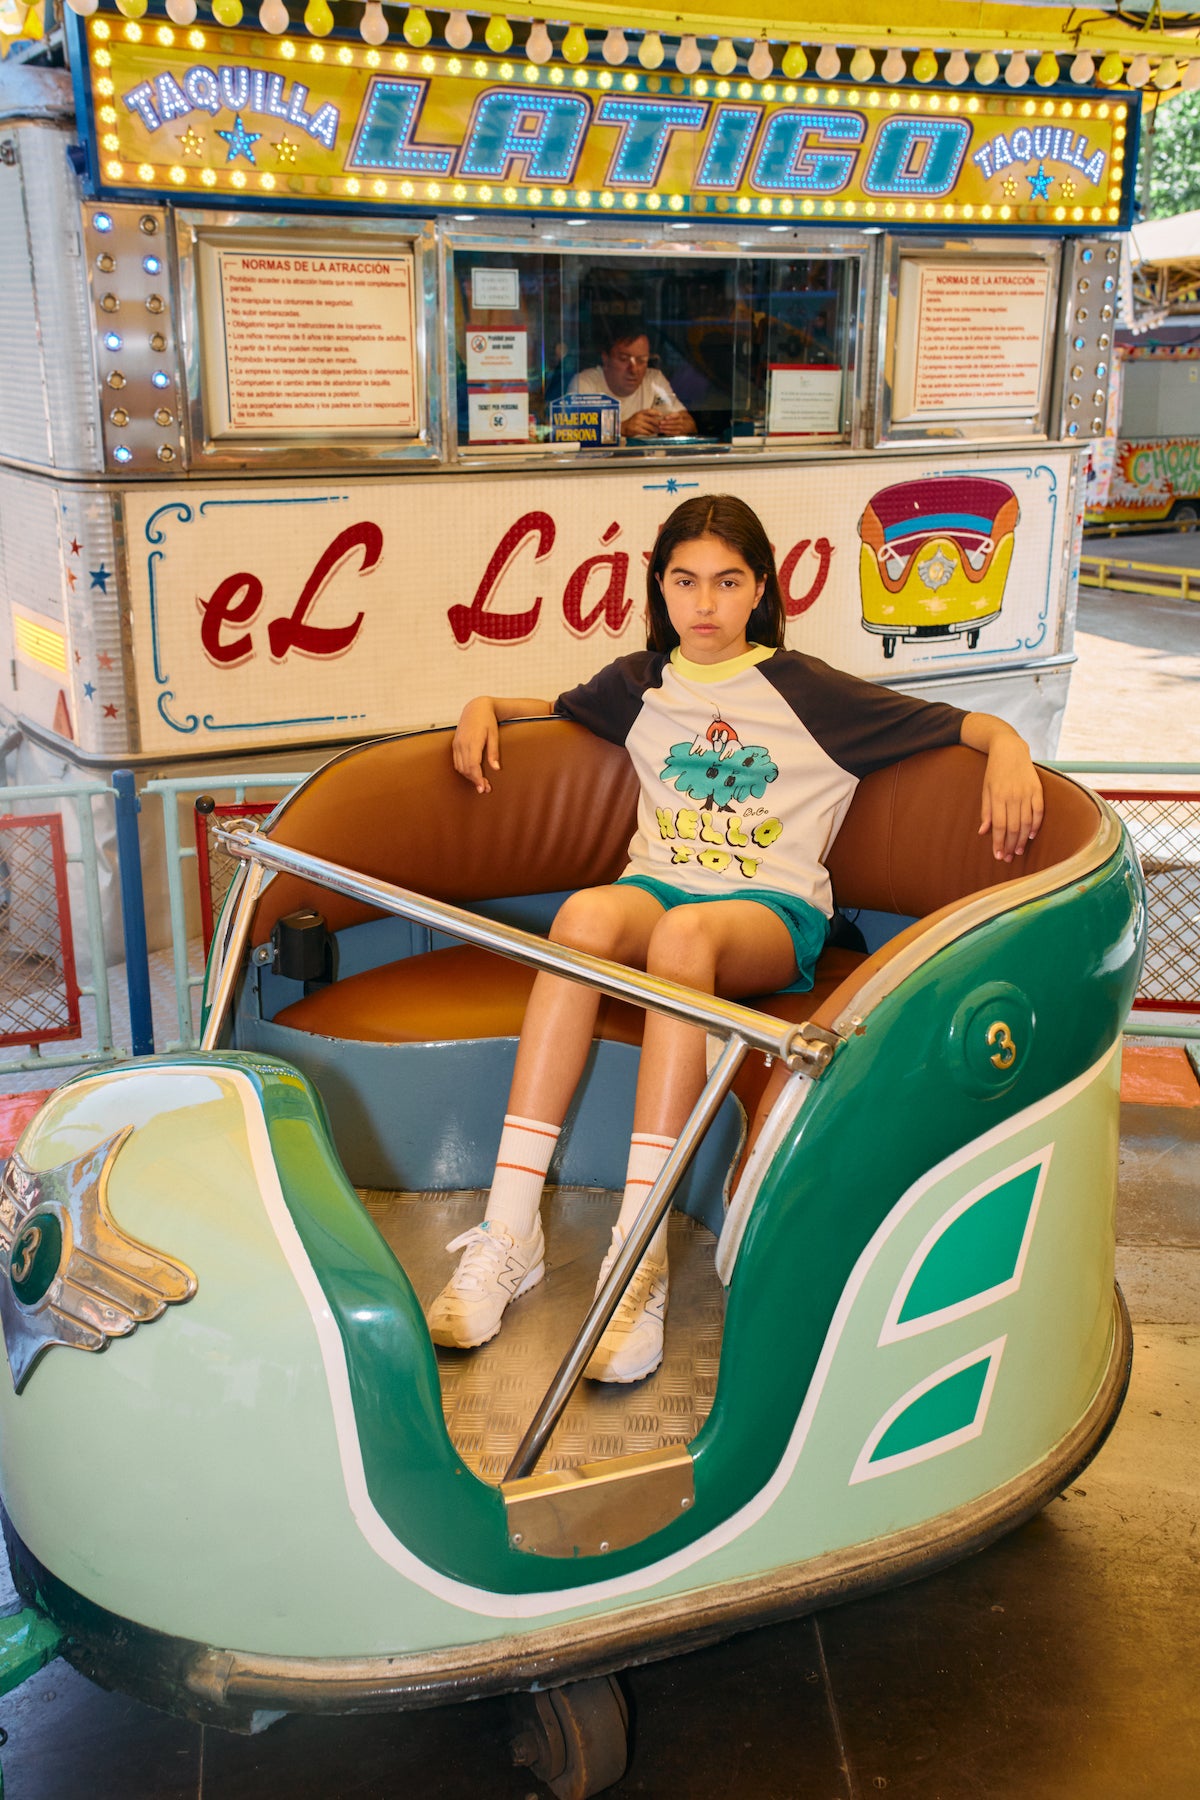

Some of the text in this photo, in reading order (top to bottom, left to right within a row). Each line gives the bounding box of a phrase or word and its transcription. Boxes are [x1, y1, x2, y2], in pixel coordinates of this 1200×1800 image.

[123, 64, 341, 150] TAQUILLA
[343, 73, 974, 200] LATIGO
[972, 124, 1106, 185] TAQUILLA
[242, 259, 390, 274] NORMAS DE LA ATRACCIÓN
[936, 276, 969, 284] NORMAS
[993, 275, 1035, 285] ATRACCIÓN
[554, 412, 598, 425] VIAJE POR
[556, 429, 597, 441] PERSONA
[656, 807, 783, 848] HELLO
[986, 1021, 1016, 1070] 3
[12, 1226, 41, 1283] 3
